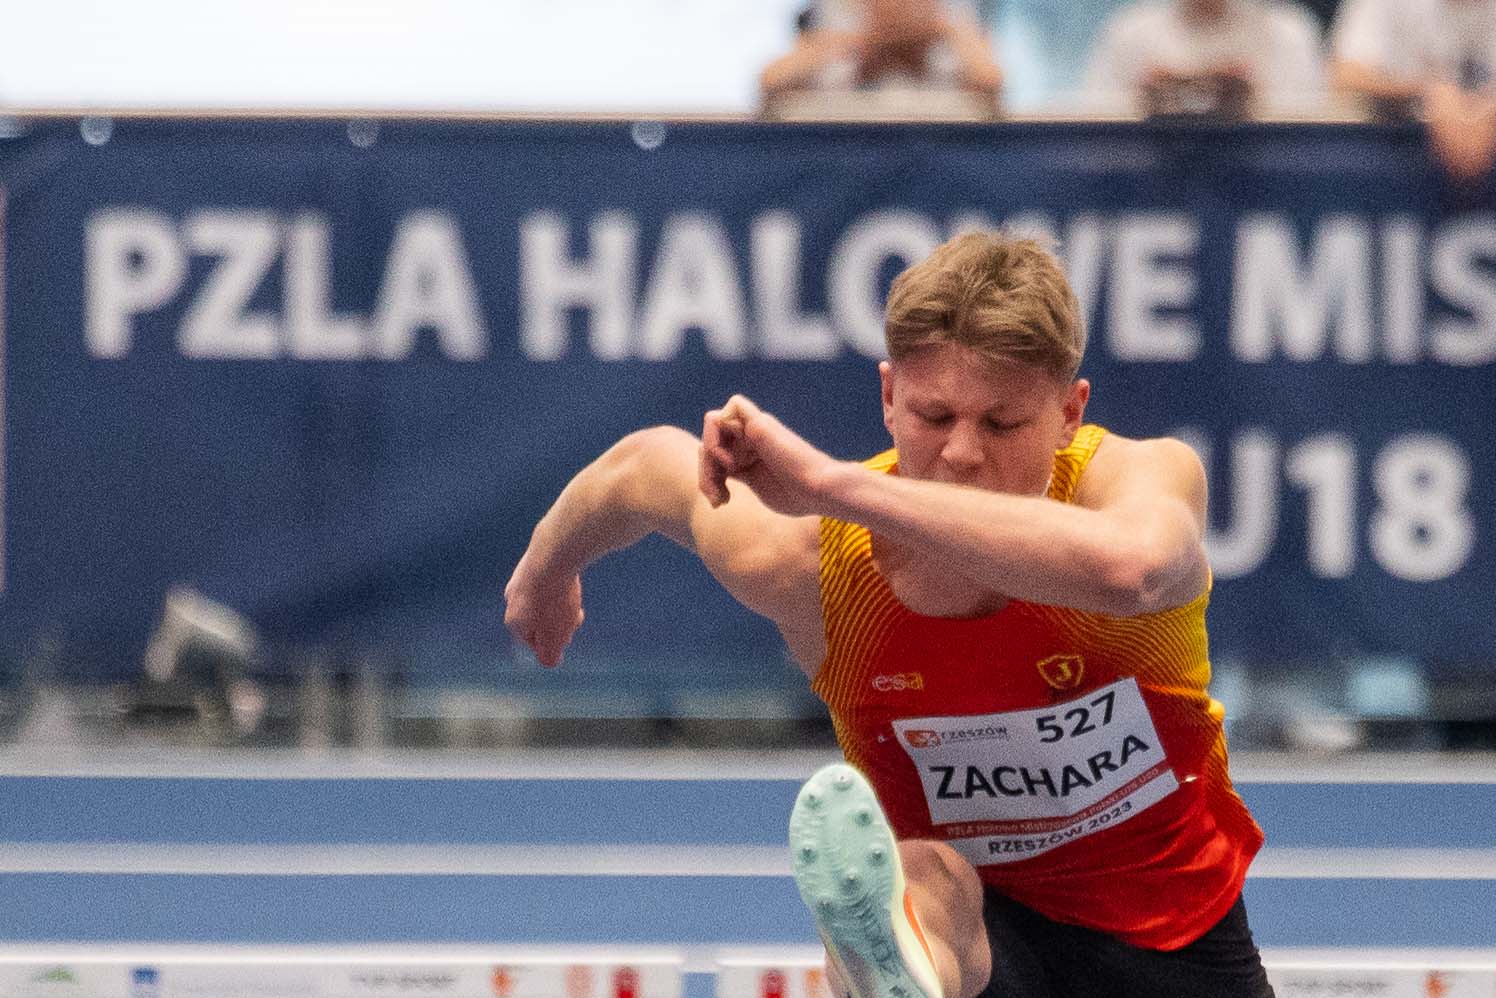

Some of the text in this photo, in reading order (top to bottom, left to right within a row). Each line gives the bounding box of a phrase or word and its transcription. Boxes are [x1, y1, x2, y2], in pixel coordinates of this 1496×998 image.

[86, 210, 482, 359] PZLA
[519, 210, 1199, 360] HALOE
[1190, 428, 1474, 581] U18
[1036, 691, 1116, 744] 527
[928, 734, 1150, 800] ZACHARA
[987, 800, 1133, 855] RZESZÓW 2023
